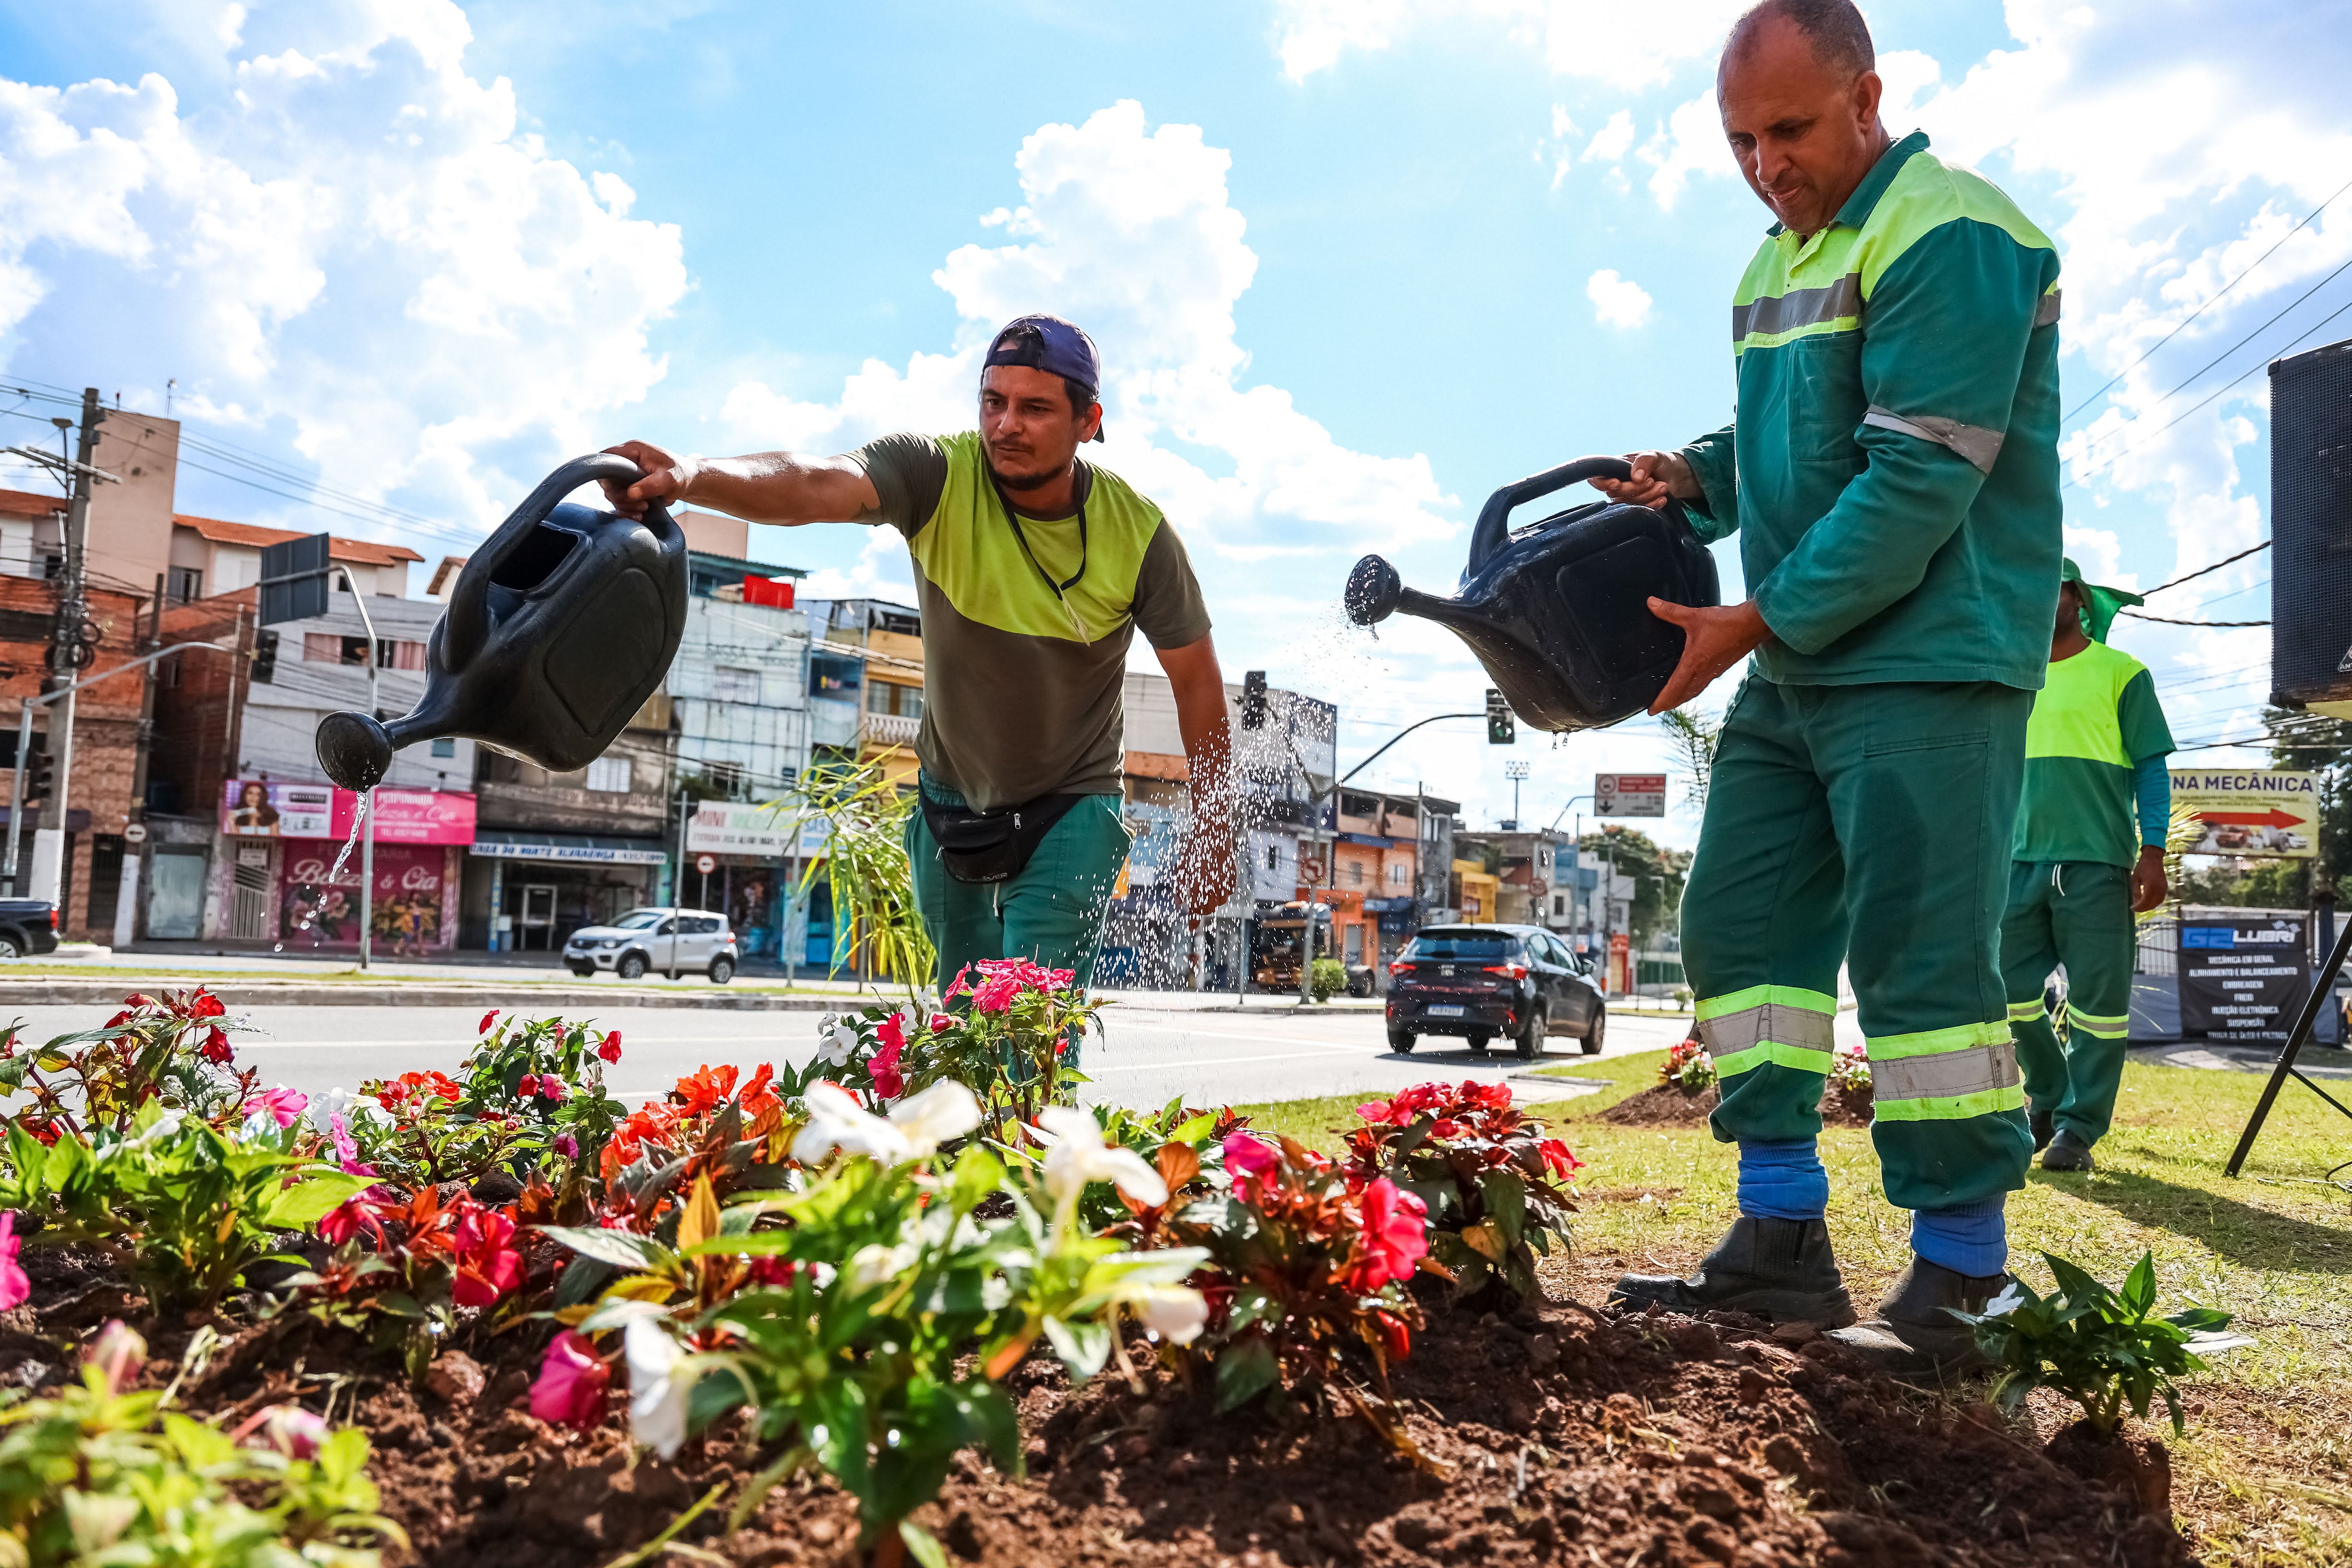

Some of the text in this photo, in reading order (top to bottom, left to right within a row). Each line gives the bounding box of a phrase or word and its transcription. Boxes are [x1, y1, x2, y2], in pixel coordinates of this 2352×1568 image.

[2205, 772, 2314, 792] MECÂNICA
[694, 810, 726, 827] MINI
[401, 865, 438, 890] Cia
